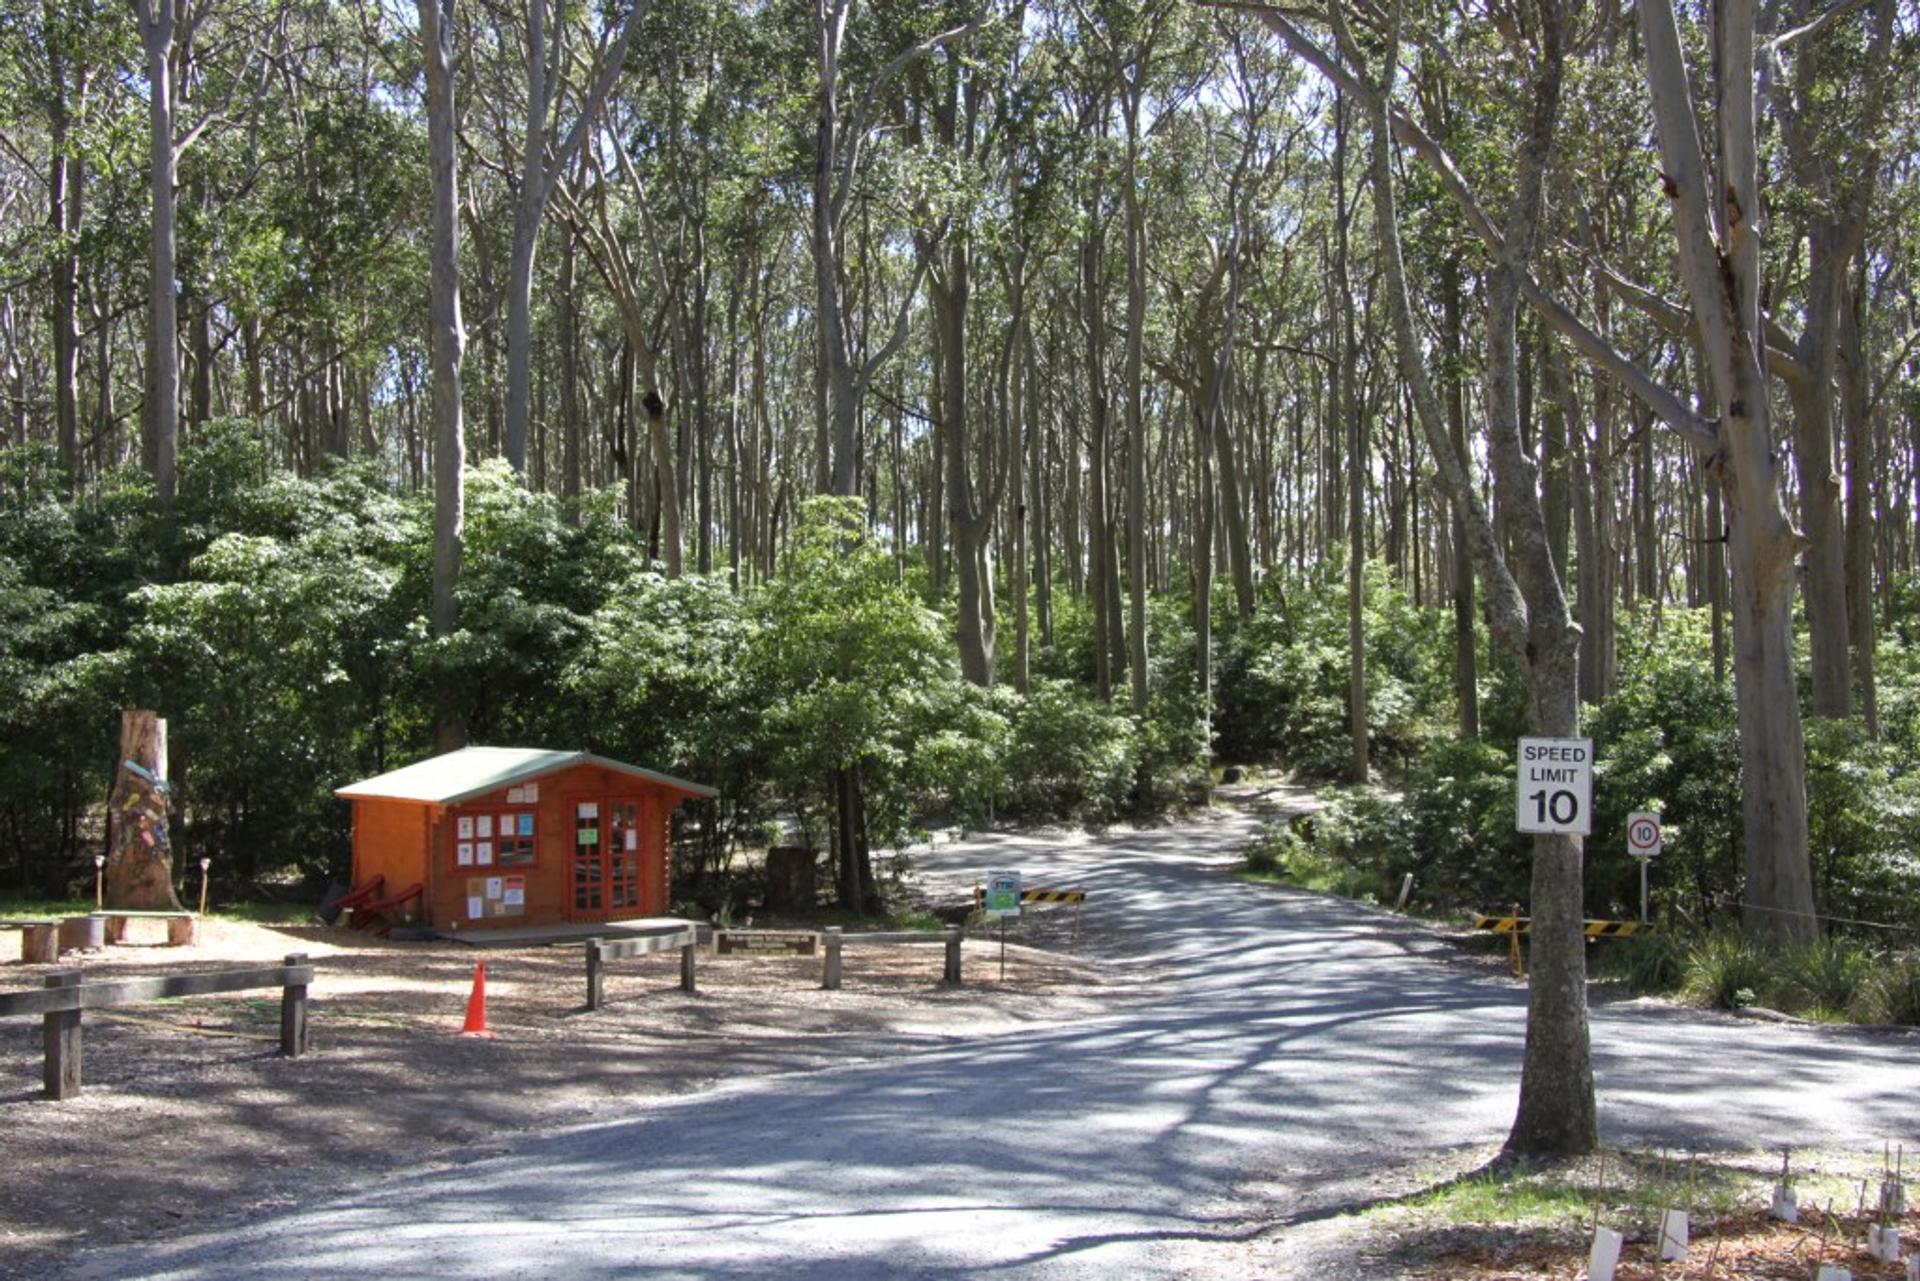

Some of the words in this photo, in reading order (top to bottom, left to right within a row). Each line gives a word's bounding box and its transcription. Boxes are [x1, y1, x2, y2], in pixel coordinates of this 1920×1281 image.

[1524, 746, 1586, 762] SPEED
[1530, 768, 1578, 783] LIMIT
[1529, 789, 1579, 825] 10
[1637, 827, 1652, 841] 10
